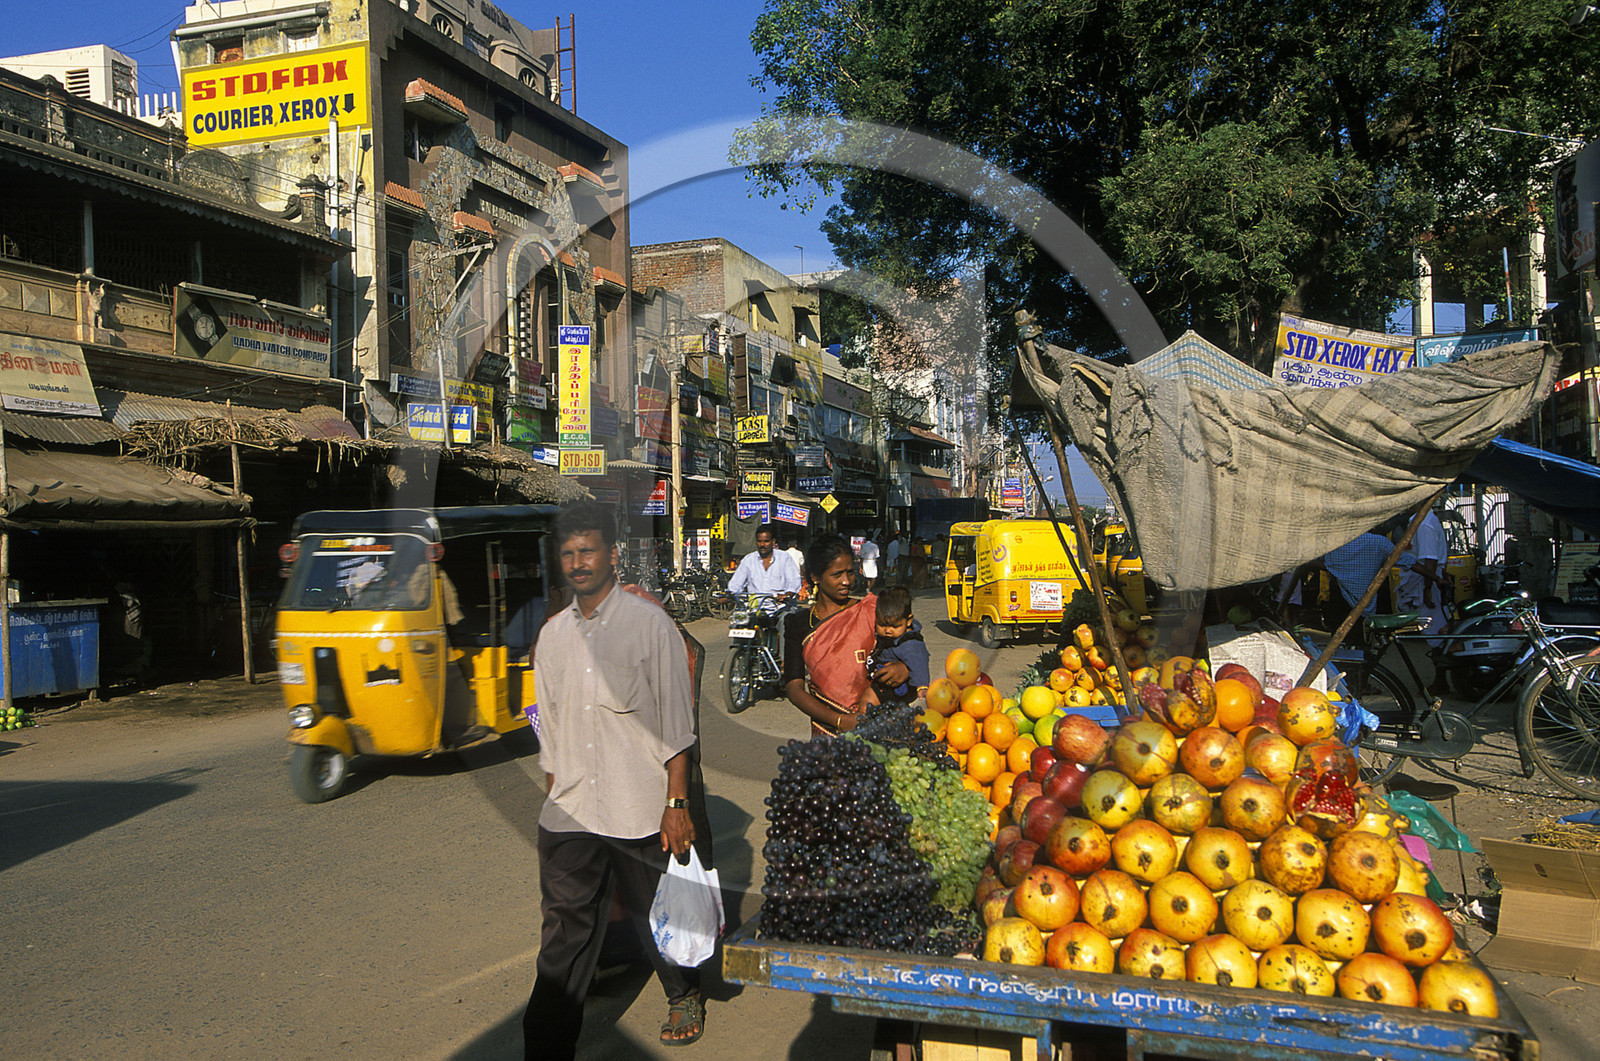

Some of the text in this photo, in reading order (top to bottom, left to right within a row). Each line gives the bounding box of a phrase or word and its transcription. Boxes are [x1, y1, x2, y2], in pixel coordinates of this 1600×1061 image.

[279, 95, 339, 123] XEROX
[233, 336, 328, 362] RADHA WATCH COMPANY
[1283, 331, 1318, 360] STD
[1317, 338, 1372, 371] XEROX
[1371, 347, 1405, 374] FAX
[1317, 367, 1363, 385] ஆண்டு
[741, 419, 764, 430] KASI
